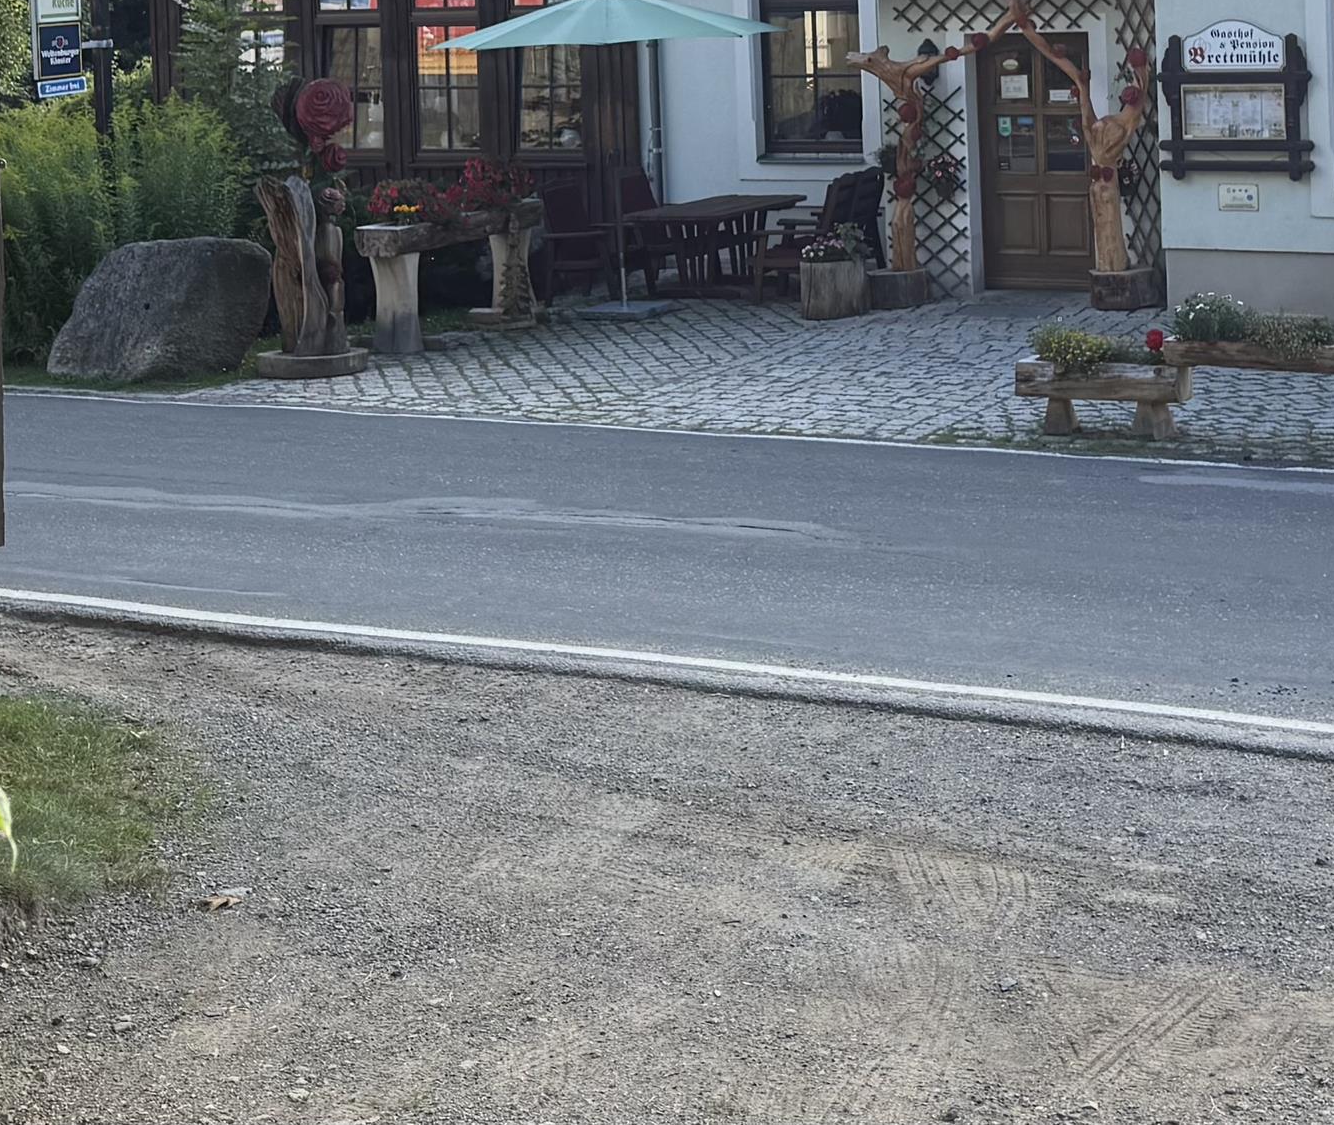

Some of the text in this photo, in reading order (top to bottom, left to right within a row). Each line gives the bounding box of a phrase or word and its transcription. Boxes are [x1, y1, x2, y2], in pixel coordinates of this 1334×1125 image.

[1210, 28, 1254, 40] Gasthof
[1230, 38, 1275, 51] Pension
[1188, 46, 1280, 65] Brettmühle
